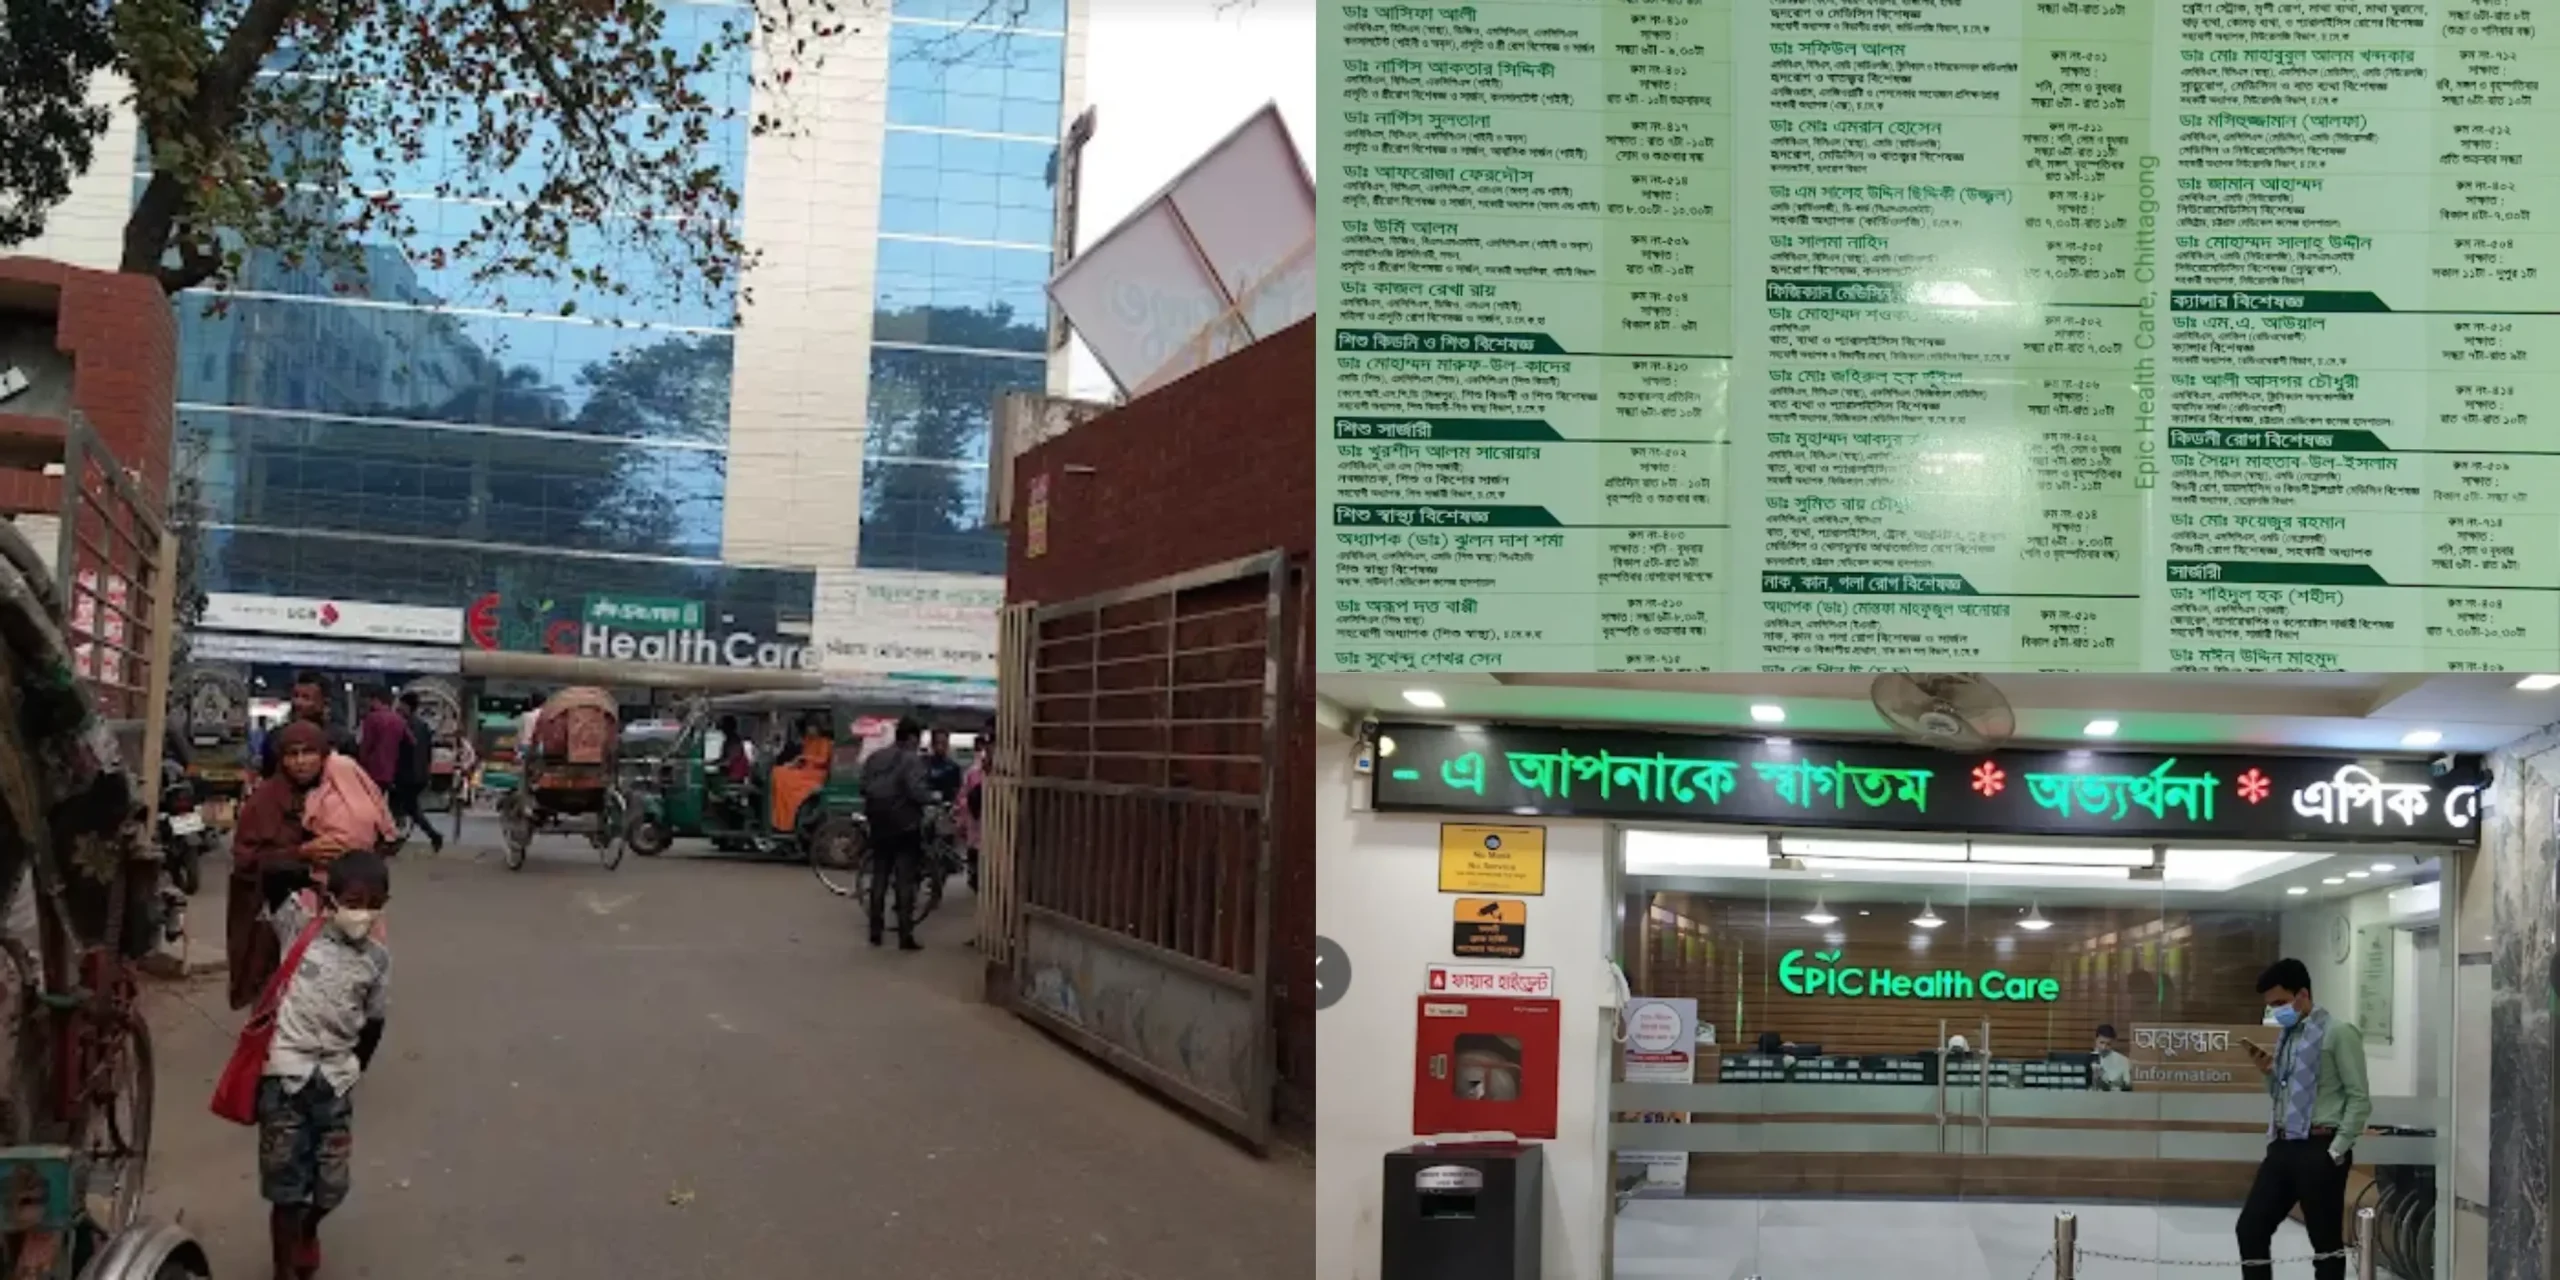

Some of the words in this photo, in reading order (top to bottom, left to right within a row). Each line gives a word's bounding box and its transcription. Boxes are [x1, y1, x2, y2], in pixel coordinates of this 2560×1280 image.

[2233, 293, 2304, 309] বিশেষজ্ঞ
[1339, 334, 1368, 349] শিশু
[1373, 334, 1419, 350] কিডনি
[1424, 337, 1435, 350] ও
[1441, 334, 1470, 351] শিশু
[1475, 335, 1534, 352] বিশেষজ্ঞ
[2171, 430, 2220, 446] কিডনী
[2226, 433, 2261, 446] রোগ
[2266, 432, 2333, 447] বিশেষজ্ঞ
[1337, 507, 1371, 523] শিশু
[1377, 509, 1415, 525] স্বাস্থ্য
[1420, 507, 1489, 524] বিশেষজ্ঞ
[582, 625, 715, 667] Health
[724, 629, 825, 672] Care
[1441, 750, 1486, 796] এ
[1506, 748, 1738, 805] আপনাকে
[1753, 757, 1934, 813] স্বাগতম
[2025, 757, 2221, 821] অভ্যর্থনা
[2293, 764, 2430, 825] এপিক
[1451, 973, 1493, 990] ফায়ার
[1870, 969, 1975, 999] Health
[1979, 973, 2060, 1002] Care
[2133, 1028, 2229, 1056] অনুসন্ধান
[2135, 1067, 2231, 1082] Information
